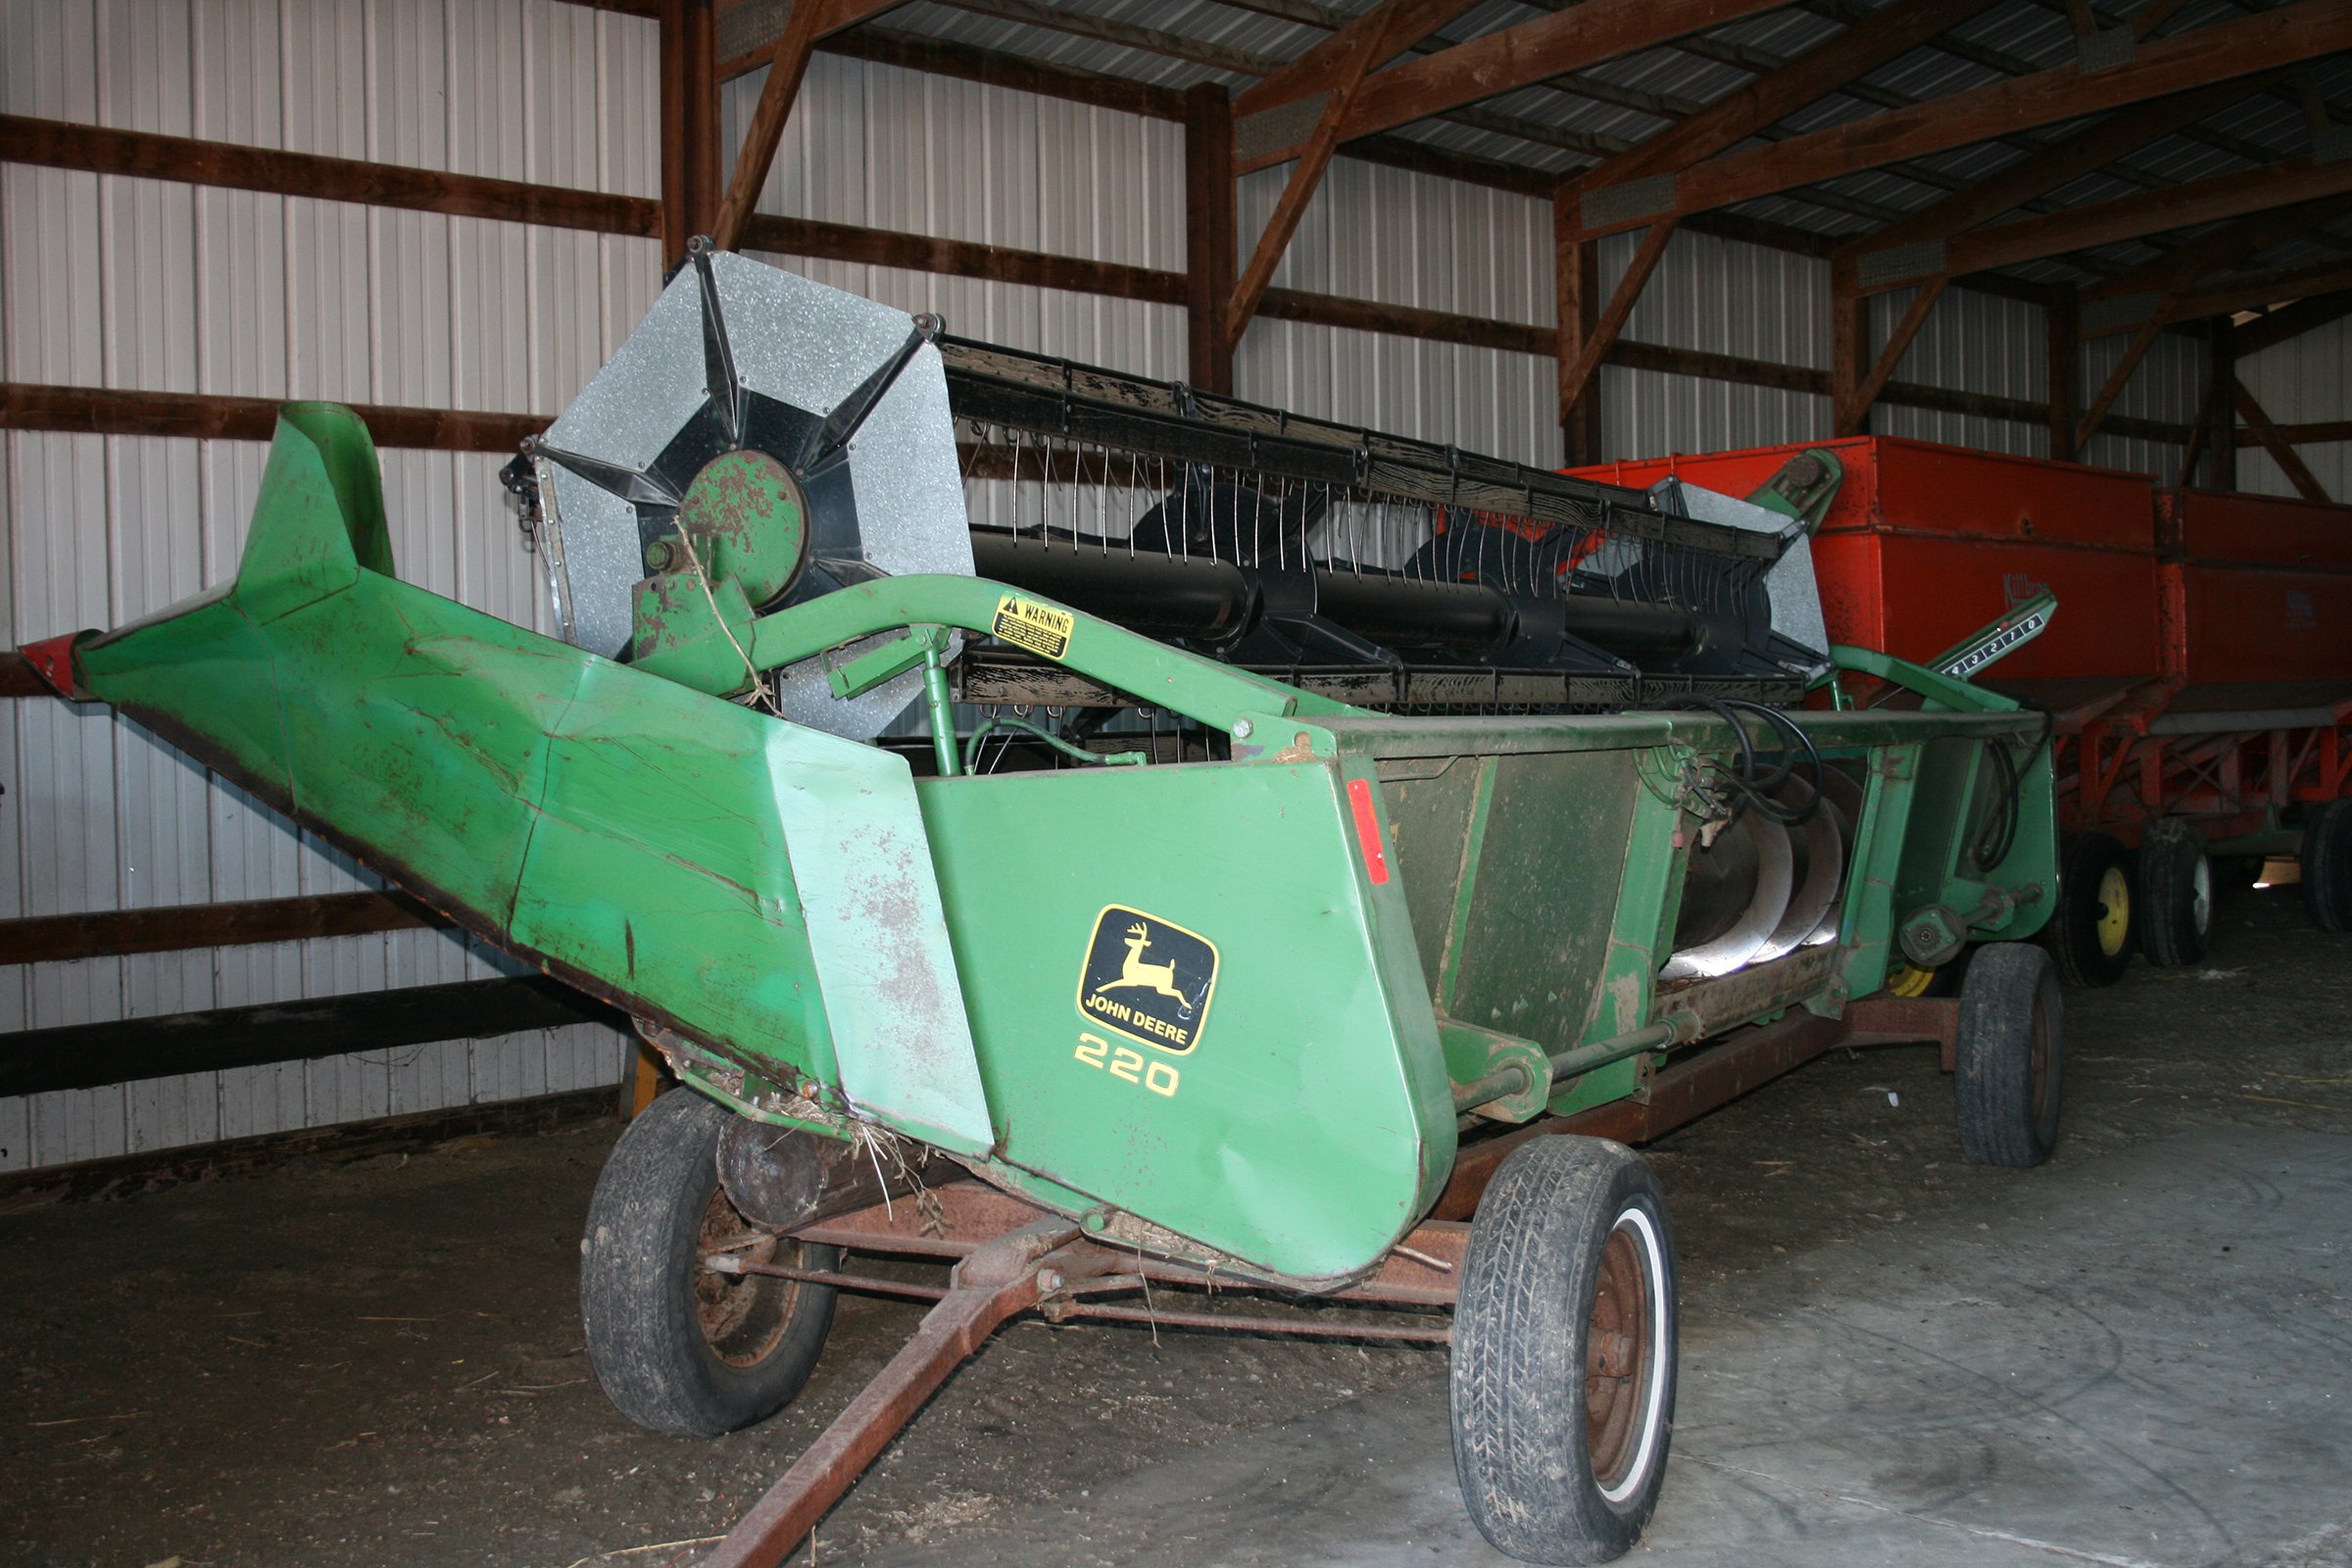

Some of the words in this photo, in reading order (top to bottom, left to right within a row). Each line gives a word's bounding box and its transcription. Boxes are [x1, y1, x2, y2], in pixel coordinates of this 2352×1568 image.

[1024, 604, 1069, 633] WARNING
[1951, 665, 1959, 675] 4
[1971, 655, 1979, 664] 3
[1990, 643, 1997, 653] 2
[2009, 631, 2015, 641] 1
[2028, 619, 2035, 629] 0
[1085, 994, 1131, 1022] JOHN
[1132, 1010, 1188, 1045] DEERE
[1074, 1032, 1180, 1098] 220
